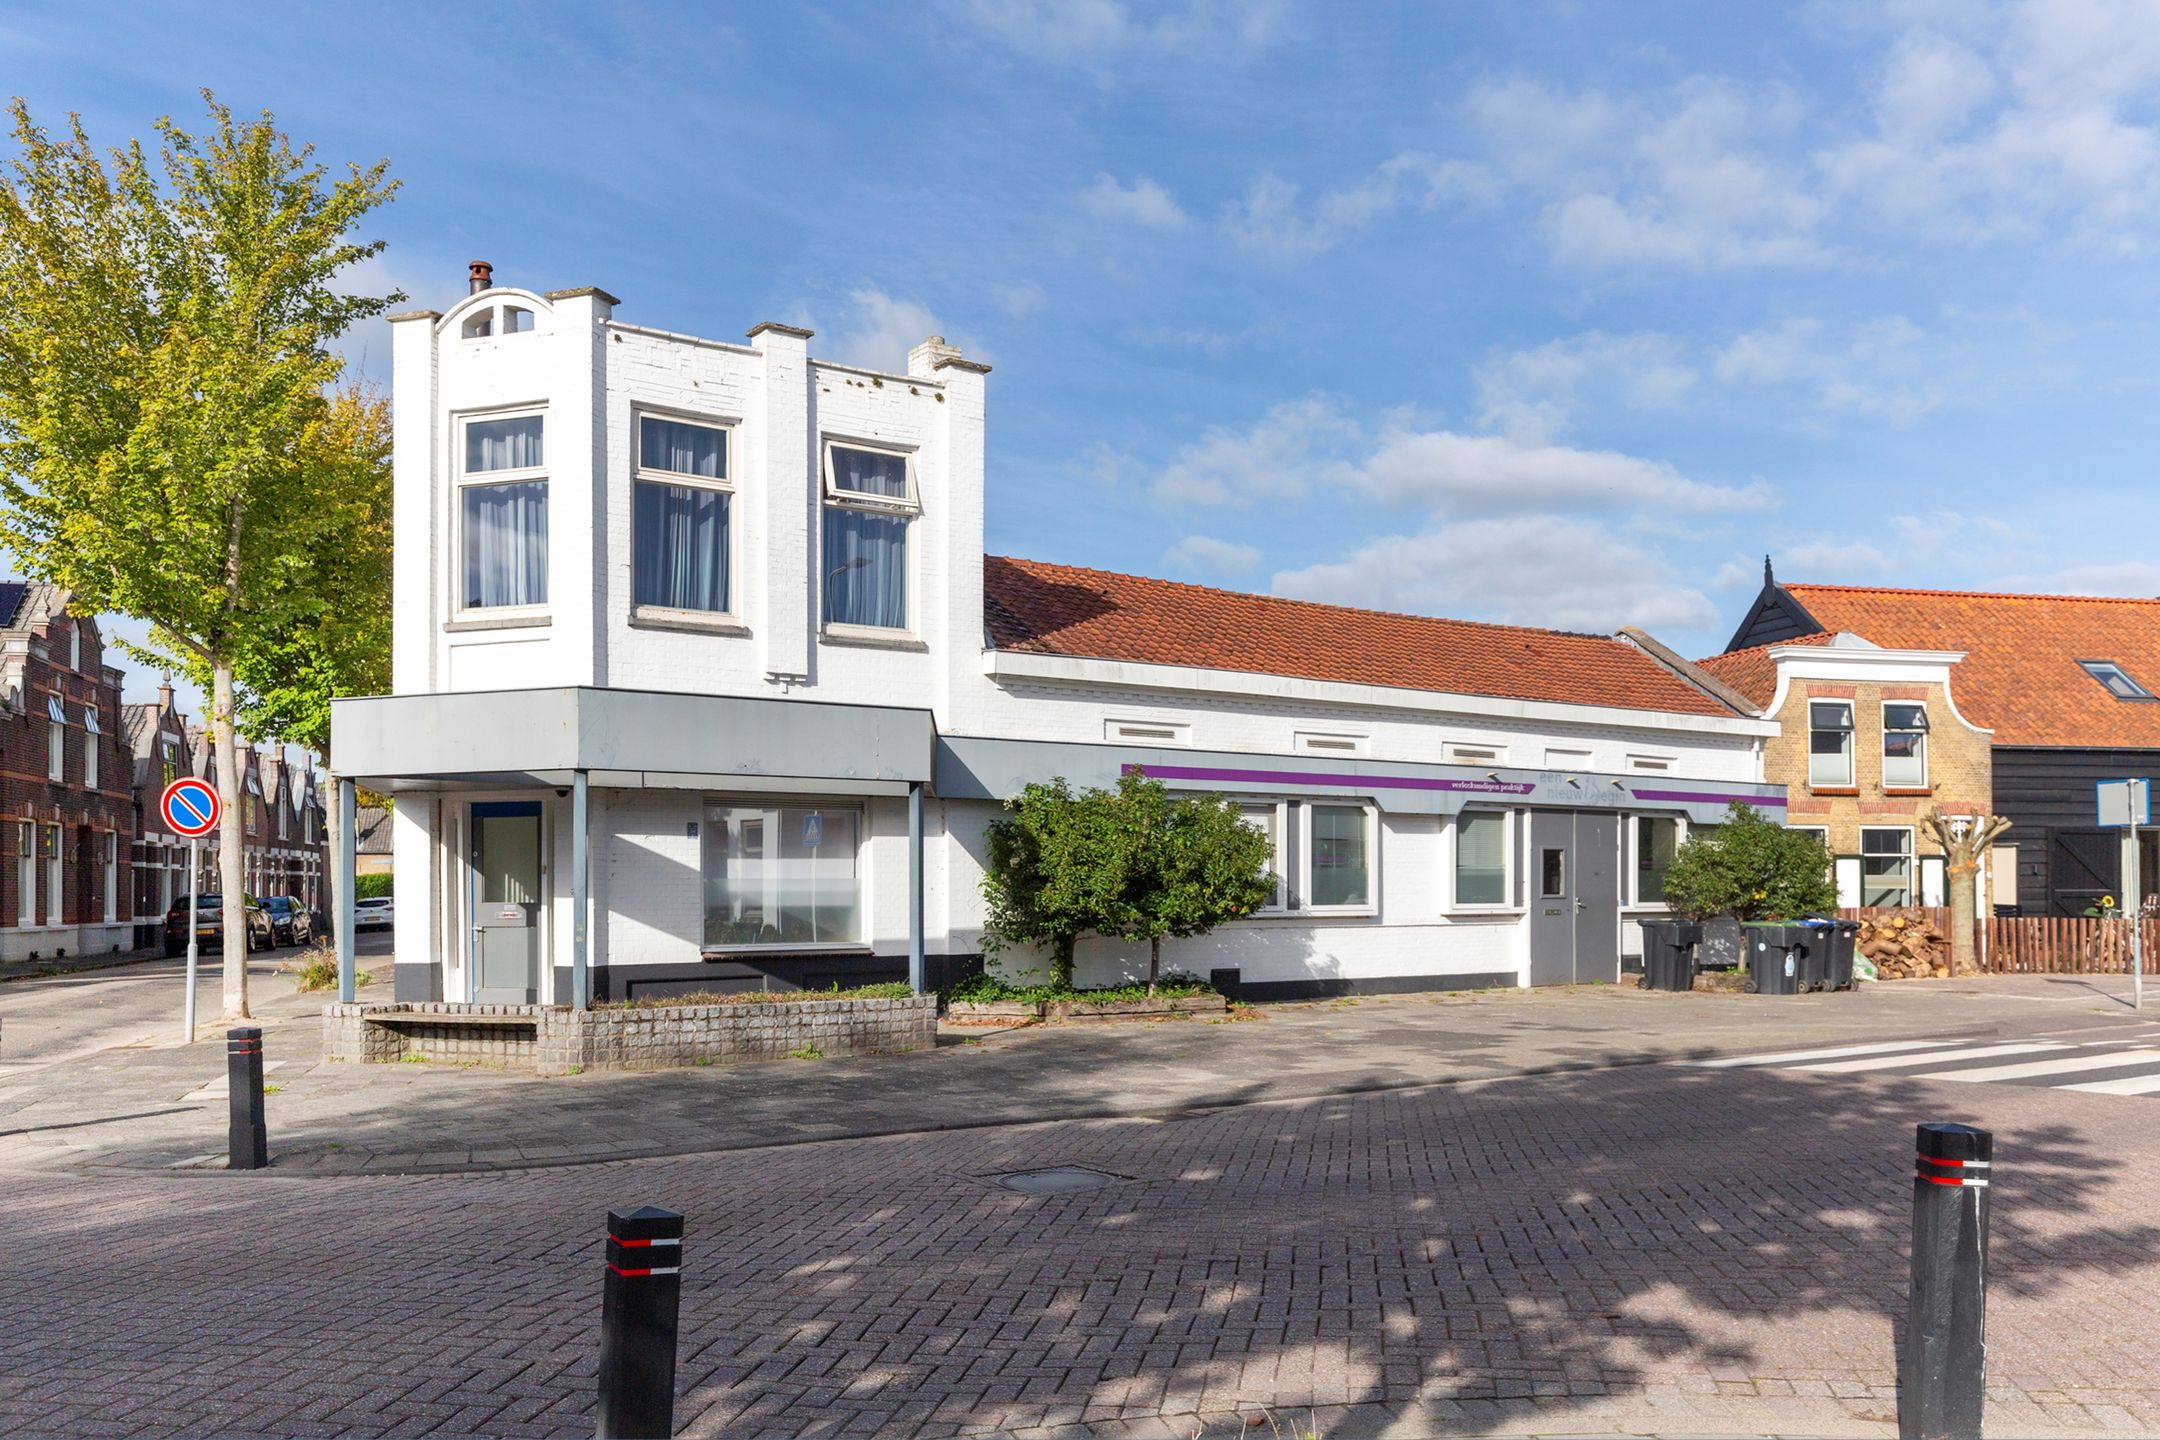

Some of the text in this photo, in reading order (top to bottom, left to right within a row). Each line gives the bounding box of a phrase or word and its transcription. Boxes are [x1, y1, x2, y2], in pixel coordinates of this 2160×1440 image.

[1539, 773, 1562, 783] een
[1500, 783, 1524, 793] praktijk
[1547, 786, 1583, 800] nieuw
